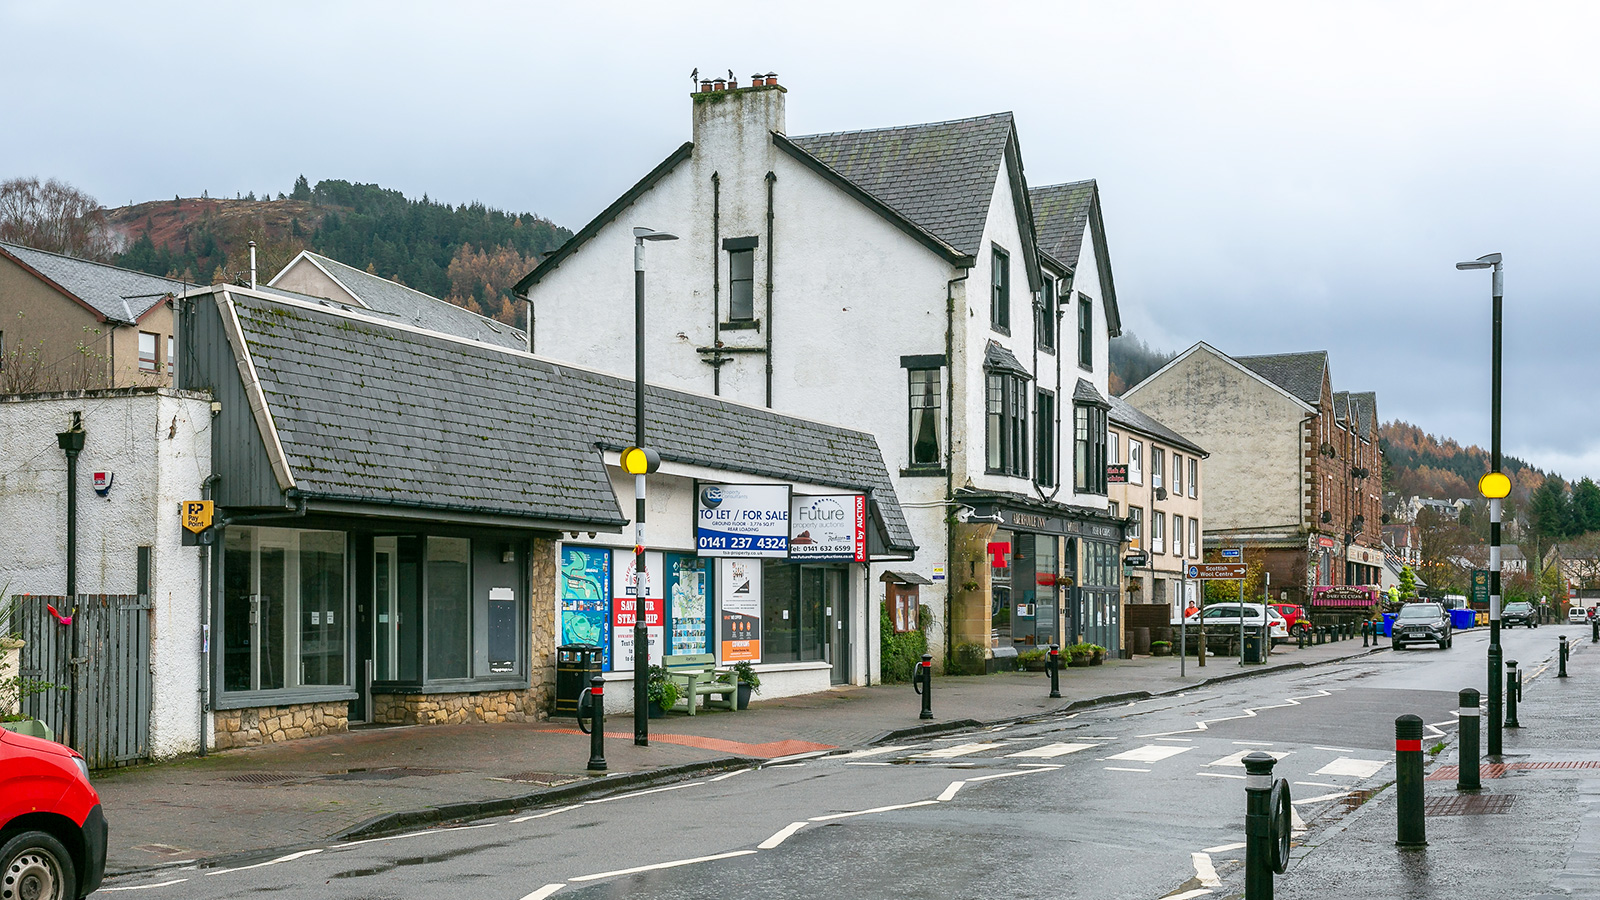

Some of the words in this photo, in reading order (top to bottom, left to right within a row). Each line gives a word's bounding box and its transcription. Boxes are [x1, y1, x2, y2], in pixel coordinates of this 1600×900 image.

[706, 488, 722, 499] tsa
[700, 509, 714, 520] TO
[716, 510, 731, 520] LET
[743, 510, 762, 521] FOR
[765, 510, 788, 521] SALE
[799, 506, 845, 521] Future
[856, 497, 864, 528] AUCTION
[856, 530, 864, 540] by
[699, 536, 726, 549] 0141
[731, 537, 752, 549] 237
[757, 537, 787, 550] 4324
[856, 542, 864, 560] SALE
[988, 542, 1011, 567] T
[617, 613, 659, 624] STEAHIP
